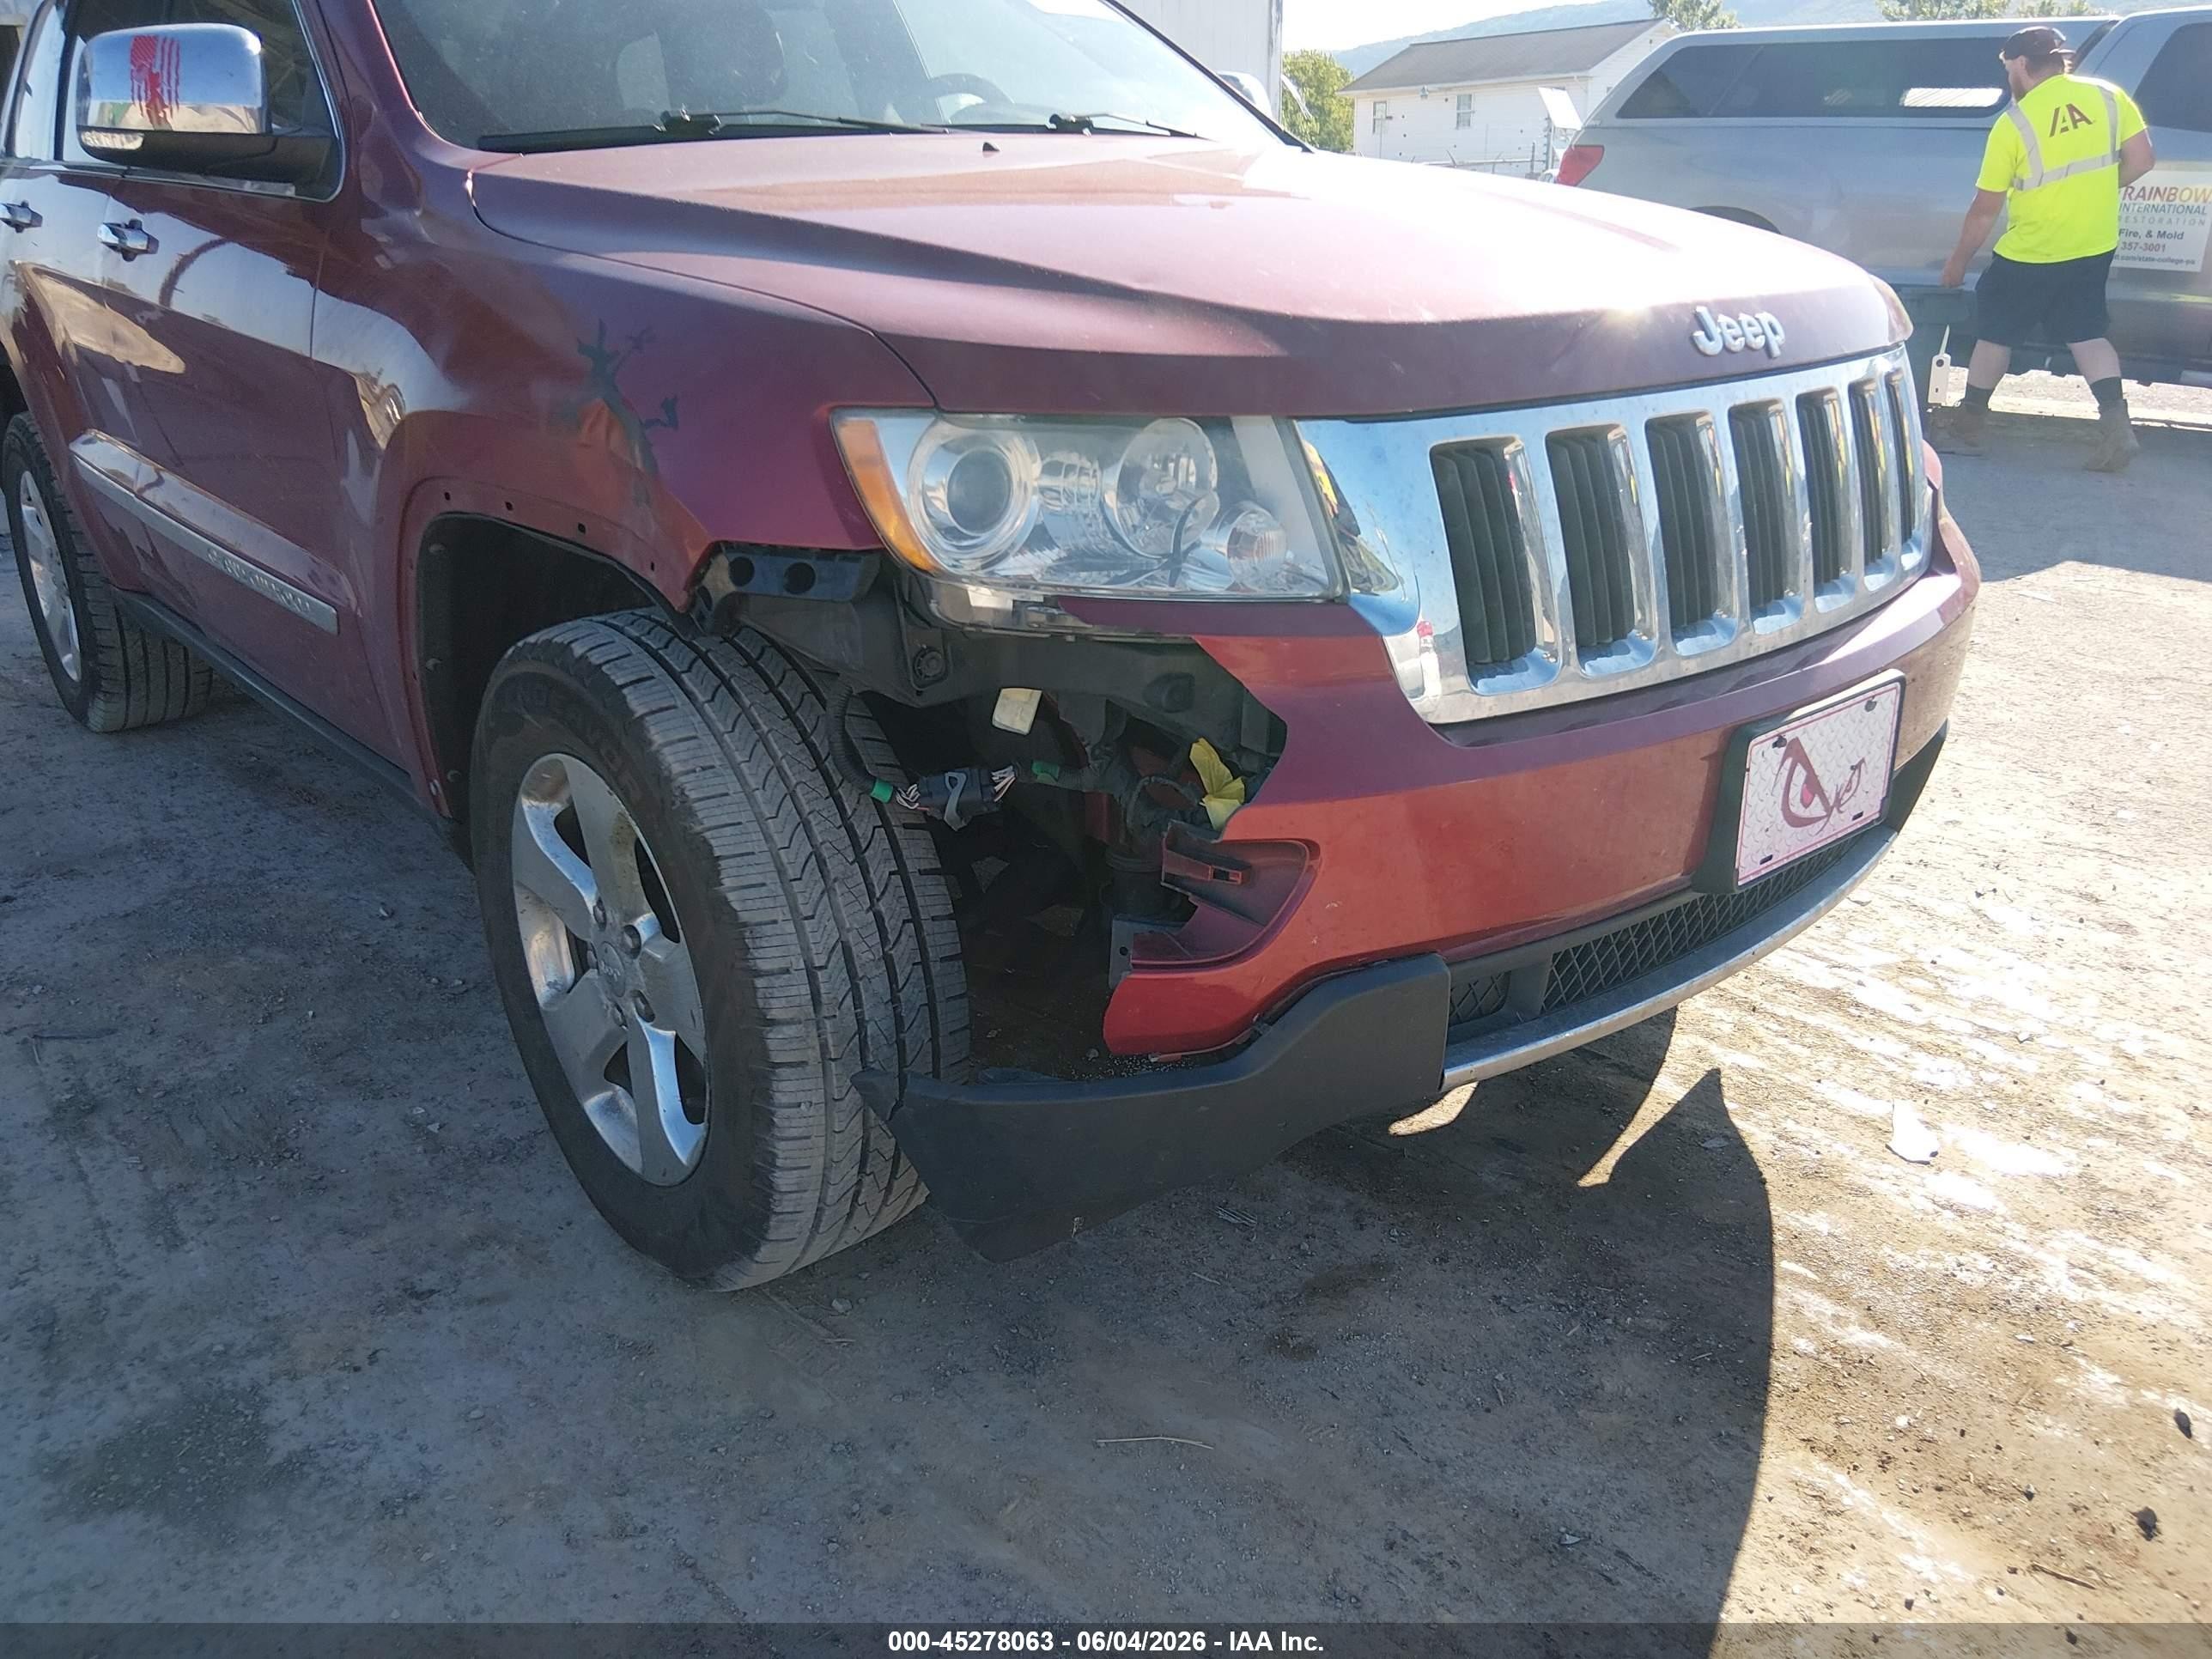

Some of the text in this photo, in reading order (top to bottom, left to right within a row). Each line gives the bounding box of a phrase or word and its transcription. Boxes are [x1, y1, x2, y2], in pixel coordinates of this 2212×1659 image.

[2122, 185, 2212, 204] RAINBOW
[2118, 202, 2207, 216] INTERNATIONAL
[2118, 228, 2185, 240] Fire, & Mold
[2121, 241, 2166, 252] 357-3001
[1692, 305, 1785, 359] Jeep
